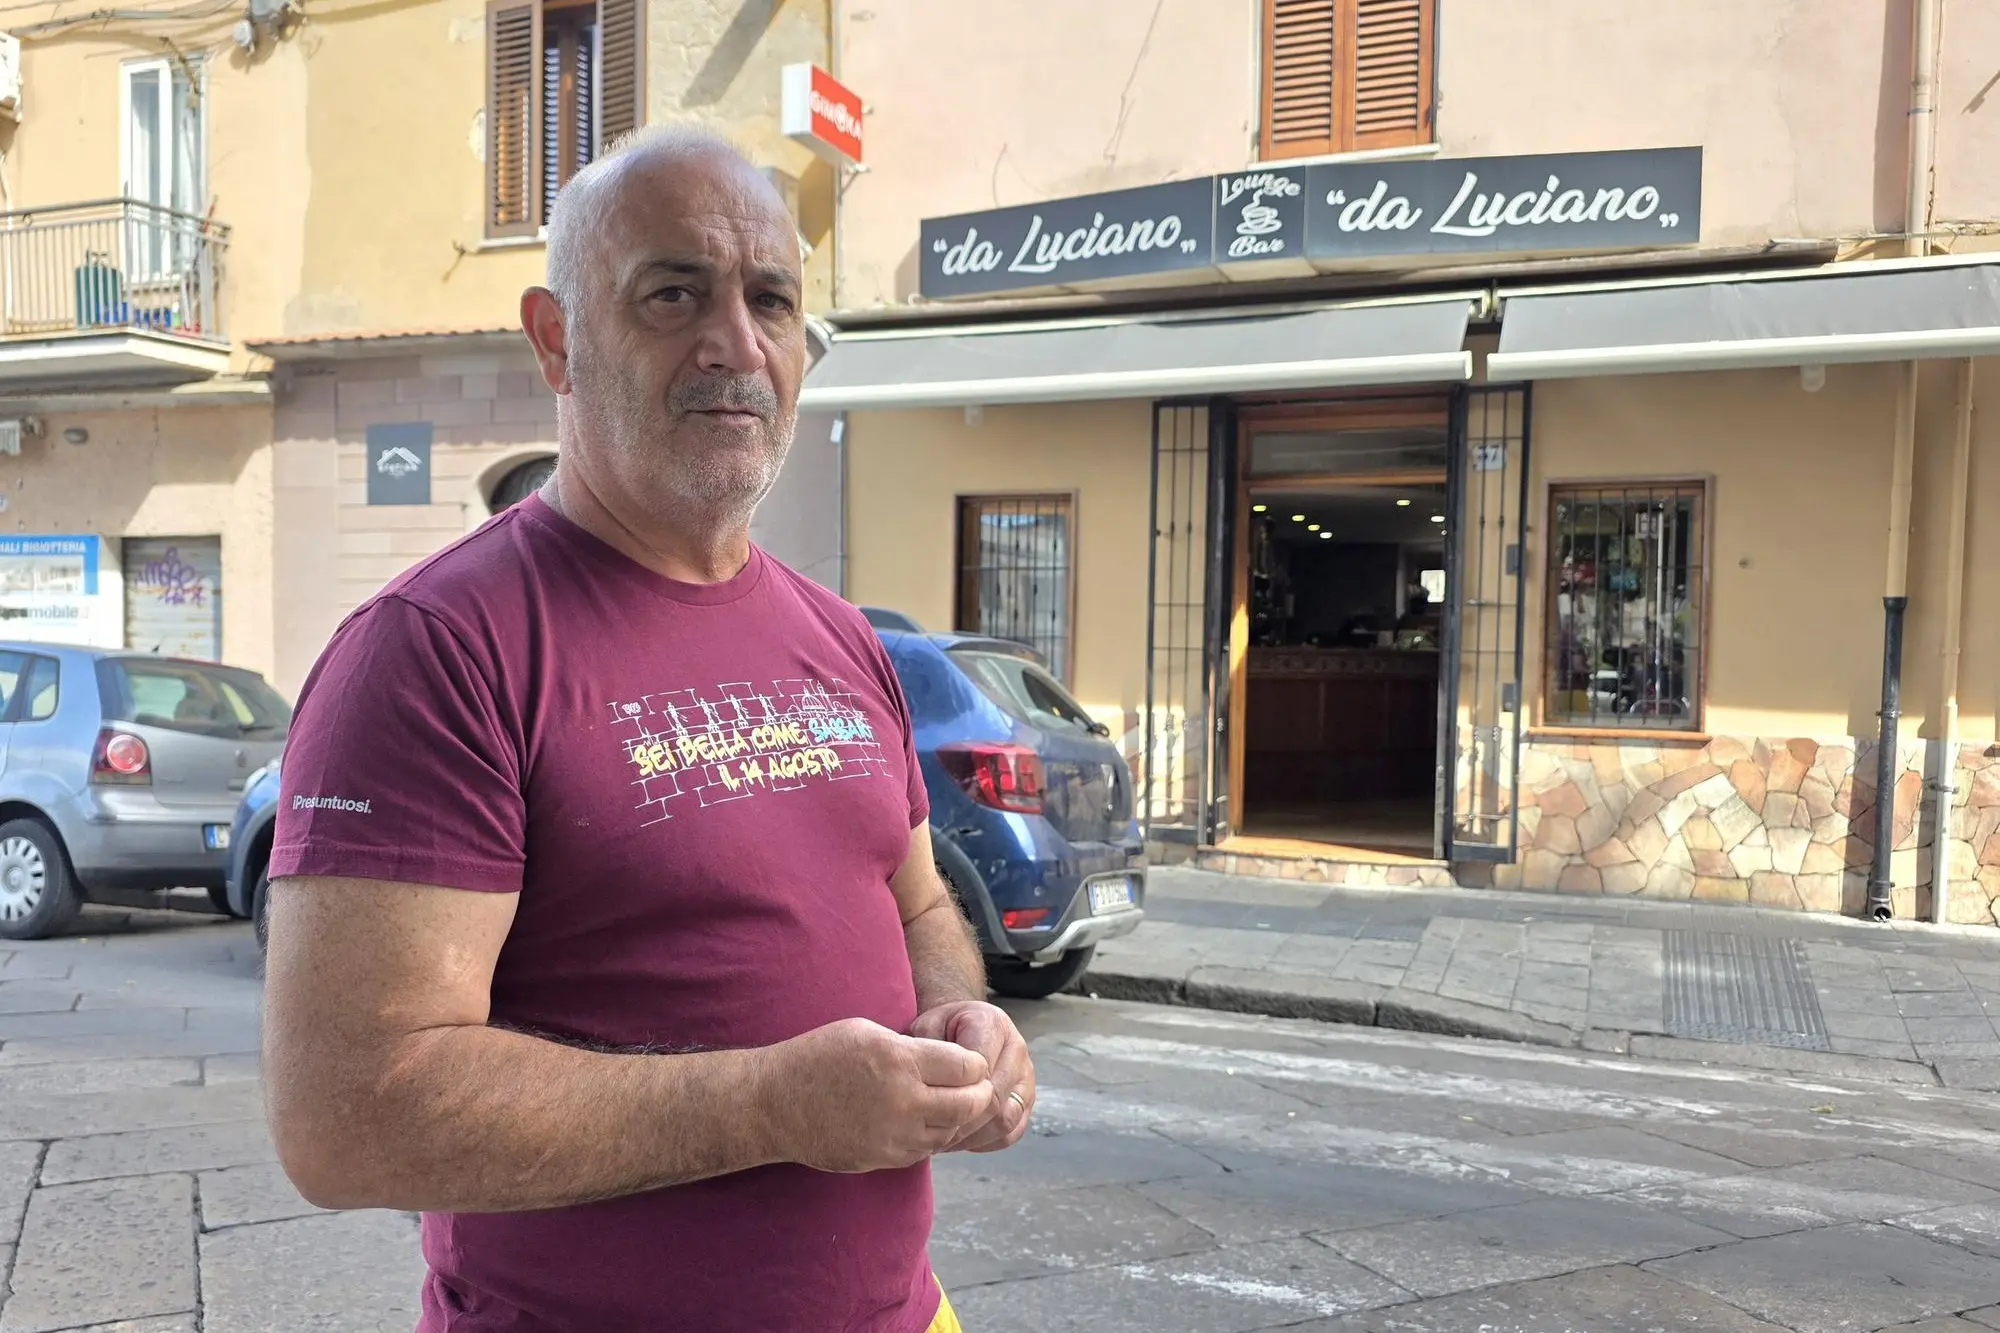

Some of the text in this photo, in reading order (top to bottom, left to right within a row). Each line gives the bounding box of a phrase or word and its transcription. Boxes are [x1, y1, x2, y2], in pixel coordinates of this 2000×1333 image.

[1220, 172, 1302, 206] Lounge
[1228, 235, 1286, 257] Bar
[675, 727, 752, 768] BELLA
[751, 721, 810, 754] COME
[767, 747, 844, 780] AGOSTO
